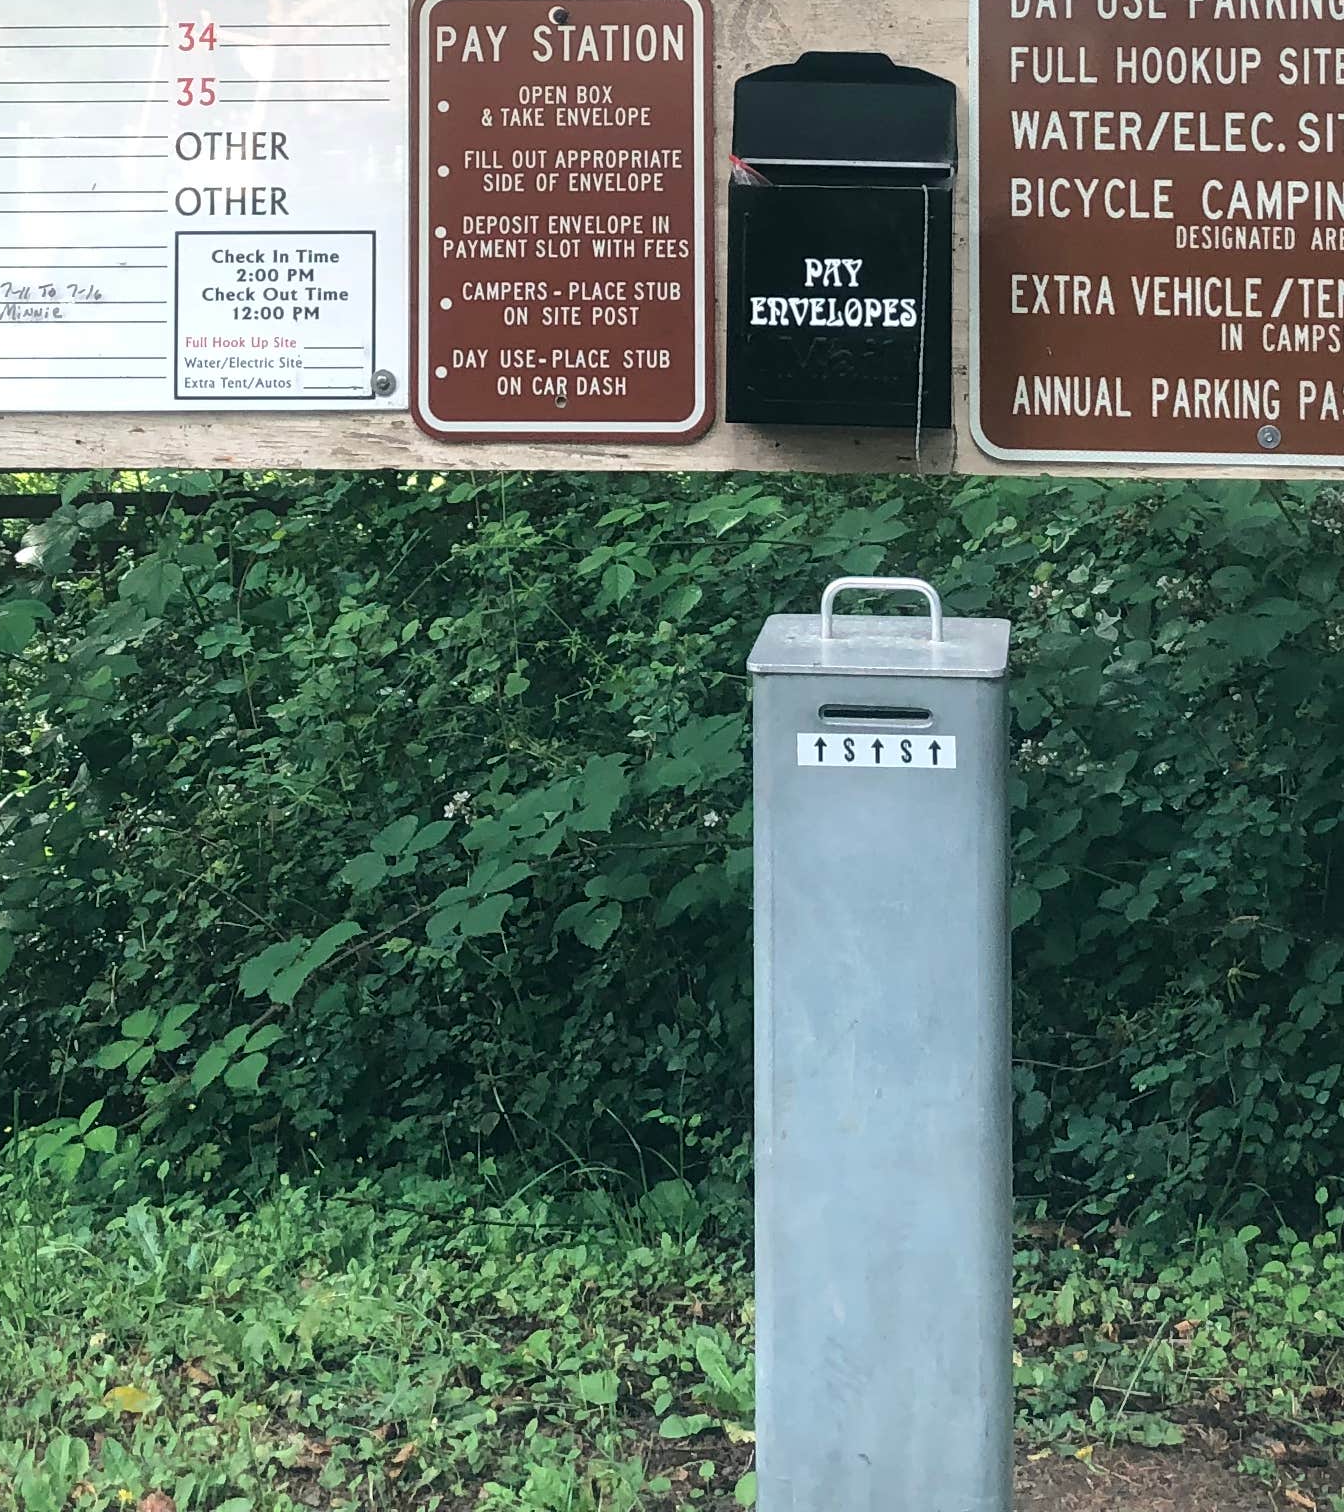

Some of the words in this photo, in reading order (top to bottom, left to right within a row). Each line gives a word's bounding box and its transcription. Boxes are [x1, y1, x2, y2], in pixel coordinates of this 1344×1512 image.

[178, 23, 217, 51] 34
[437, 25, 507, 62] PAY
[533, 25, 684, 62] STATION
[1011, 47, 1097, 84] FULL
[1118, 47, 1262, 85] HOOKUP
[177, 78, 216, 106] 35
[519, 87, 567, 104] OPEN
[577, 86, 613, 104] BOX
[482, 109, 493, 126] &
[501, 108, 544, 126] TAKE
[557, 108, 651, 126] ENVELOPE
[1012, 111, 1285, 153] WATER/ELEC.
[464, 152, 502, 169] FILL
[513, 151, 547, 169] OUT
[555, 150, 682, 169] APPROPRIATE
[1011, 179, 1174, 219] BICYCLE
[1176, 227, 1295, 251] DESIGNATED
[212, 250, 264, 263] Check
[273, 250, 288, 263] In
[296, 250, 339, 263] Time
[237, 269, 278, 282] 2:00
[288, 269, 314, 281] PM
[805, 259, 862, 287] PAY
[202, 288, 255, 301] Check
[263, 288, 298, 301] Out
[306, 288, 348, 300] Time
[233, 307, 284, 320] 12:00
[293, 307, 319, 321] PM
[750, 297, 917, 327] ENVELOPES
[186, 338, 207, 347] Full
[213, 337, 245, 347] Hook
[251, 338, 268, 349] Up
[274, 337, 296, 347] Site
[185, 358, 274, 369] Water/Electric
[279, 357, 302, 368] Site
[185, 378, 215, 388] Extra
[221, 377, 291, 388] Tent/Autos
